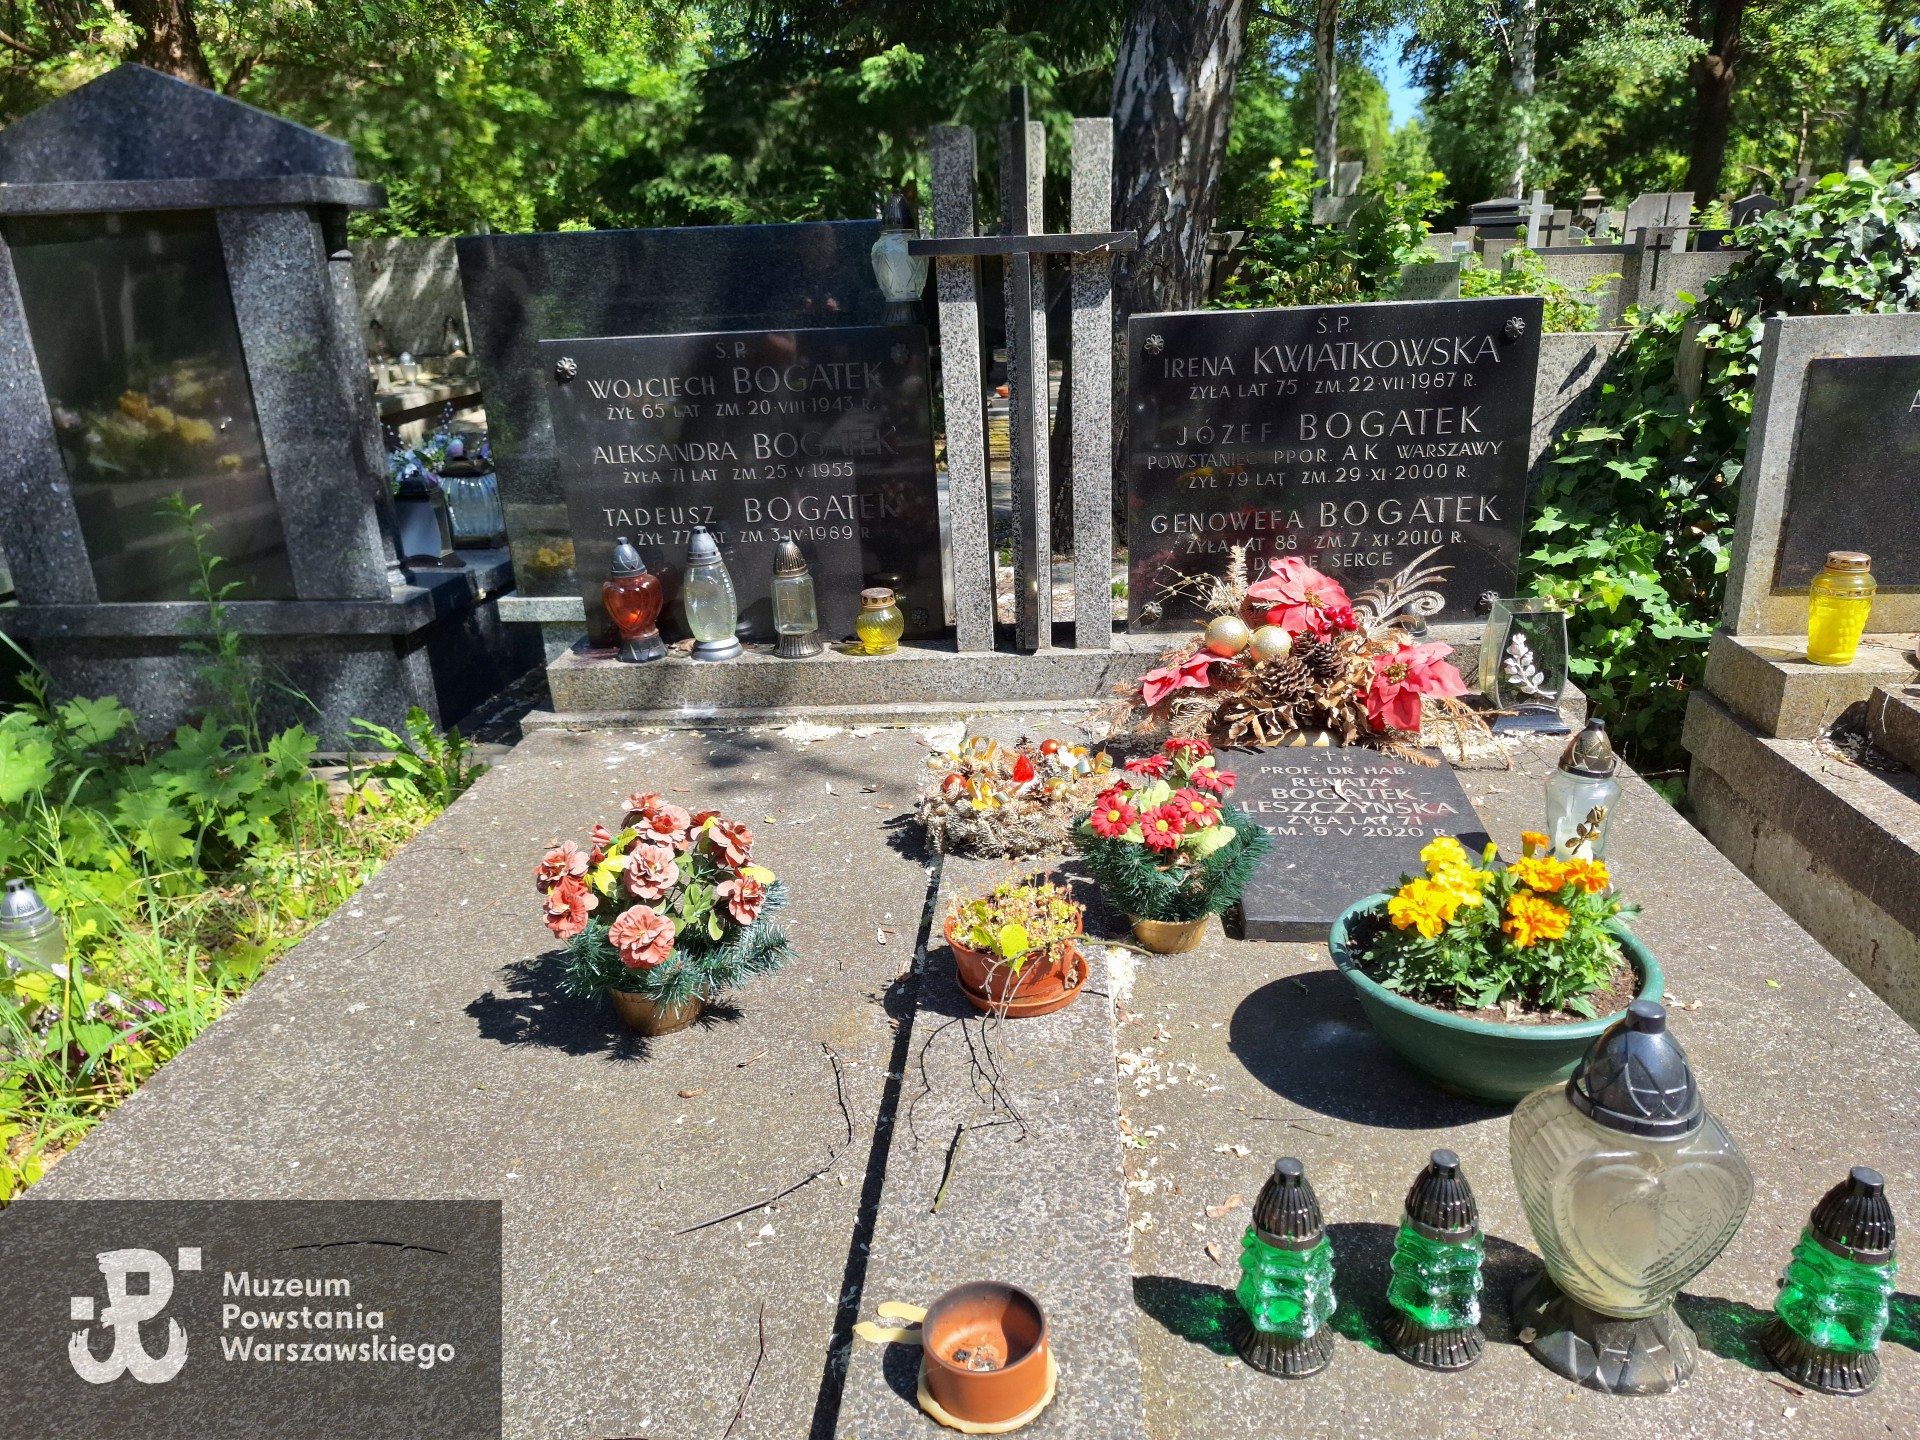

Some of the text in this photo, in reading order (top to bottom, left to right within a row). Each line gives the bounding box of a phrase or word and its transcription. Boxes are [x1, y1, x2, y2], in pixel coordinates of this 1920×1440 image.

[1164, 335, 1501, 379] IRENA KWIATKOWSKA
[586, 361, 885, 399] WOJCIECH BOGATEK
[1189, 382, 1232, 400] ŻYŁA
[1238, 383, 1268, 398] LAT
[1276, 379, 1299, 396] 75
[606, 404, 636, 420] ŻYŁ
[642, 403, 666, 419] 65
[673, 404, 701, 418] LAT
[1176, 405, 1482, 446] JÓZEF BOGATEK
[593, 428, 897, 464] ALEKSANDRA BOGATEK
[1147, 451, 1258, 470] POWSTANIEC
[1274, 448, 1333, 464] PPOR.
[1396, 440, 1503, 460] WARSZAWY
[623, 468, 662, 484] ŻYŁA
[669, 468, 685, 483] 71
[691, 468, 719, 482] LAT
[1227, 472, 1249, 487] 79
[1256, 472, 1286, 487] LAT
[602, 493, 900, 527] TADEUSZ BOGATEK
[1151, 494, 1502, 534] GENOWEFA BOGATEK
[638, 531, 666, 546] ŻYŁ
[672, 530, 691, 545] 77
[1274, 535, 1298, 550] 88
[1331, 551, 1393, 568] SERCE
[1260, 766, 1412, 775] PROF. DR HAB.
[1291, 778, 1391, 788] RENATA
[1397, 815, 1423, 826] 71
[1312, 826, 1328, 836] 9
[1337, 827, 1353, 836] V
[1362, 826, 1425, 837] 2020
